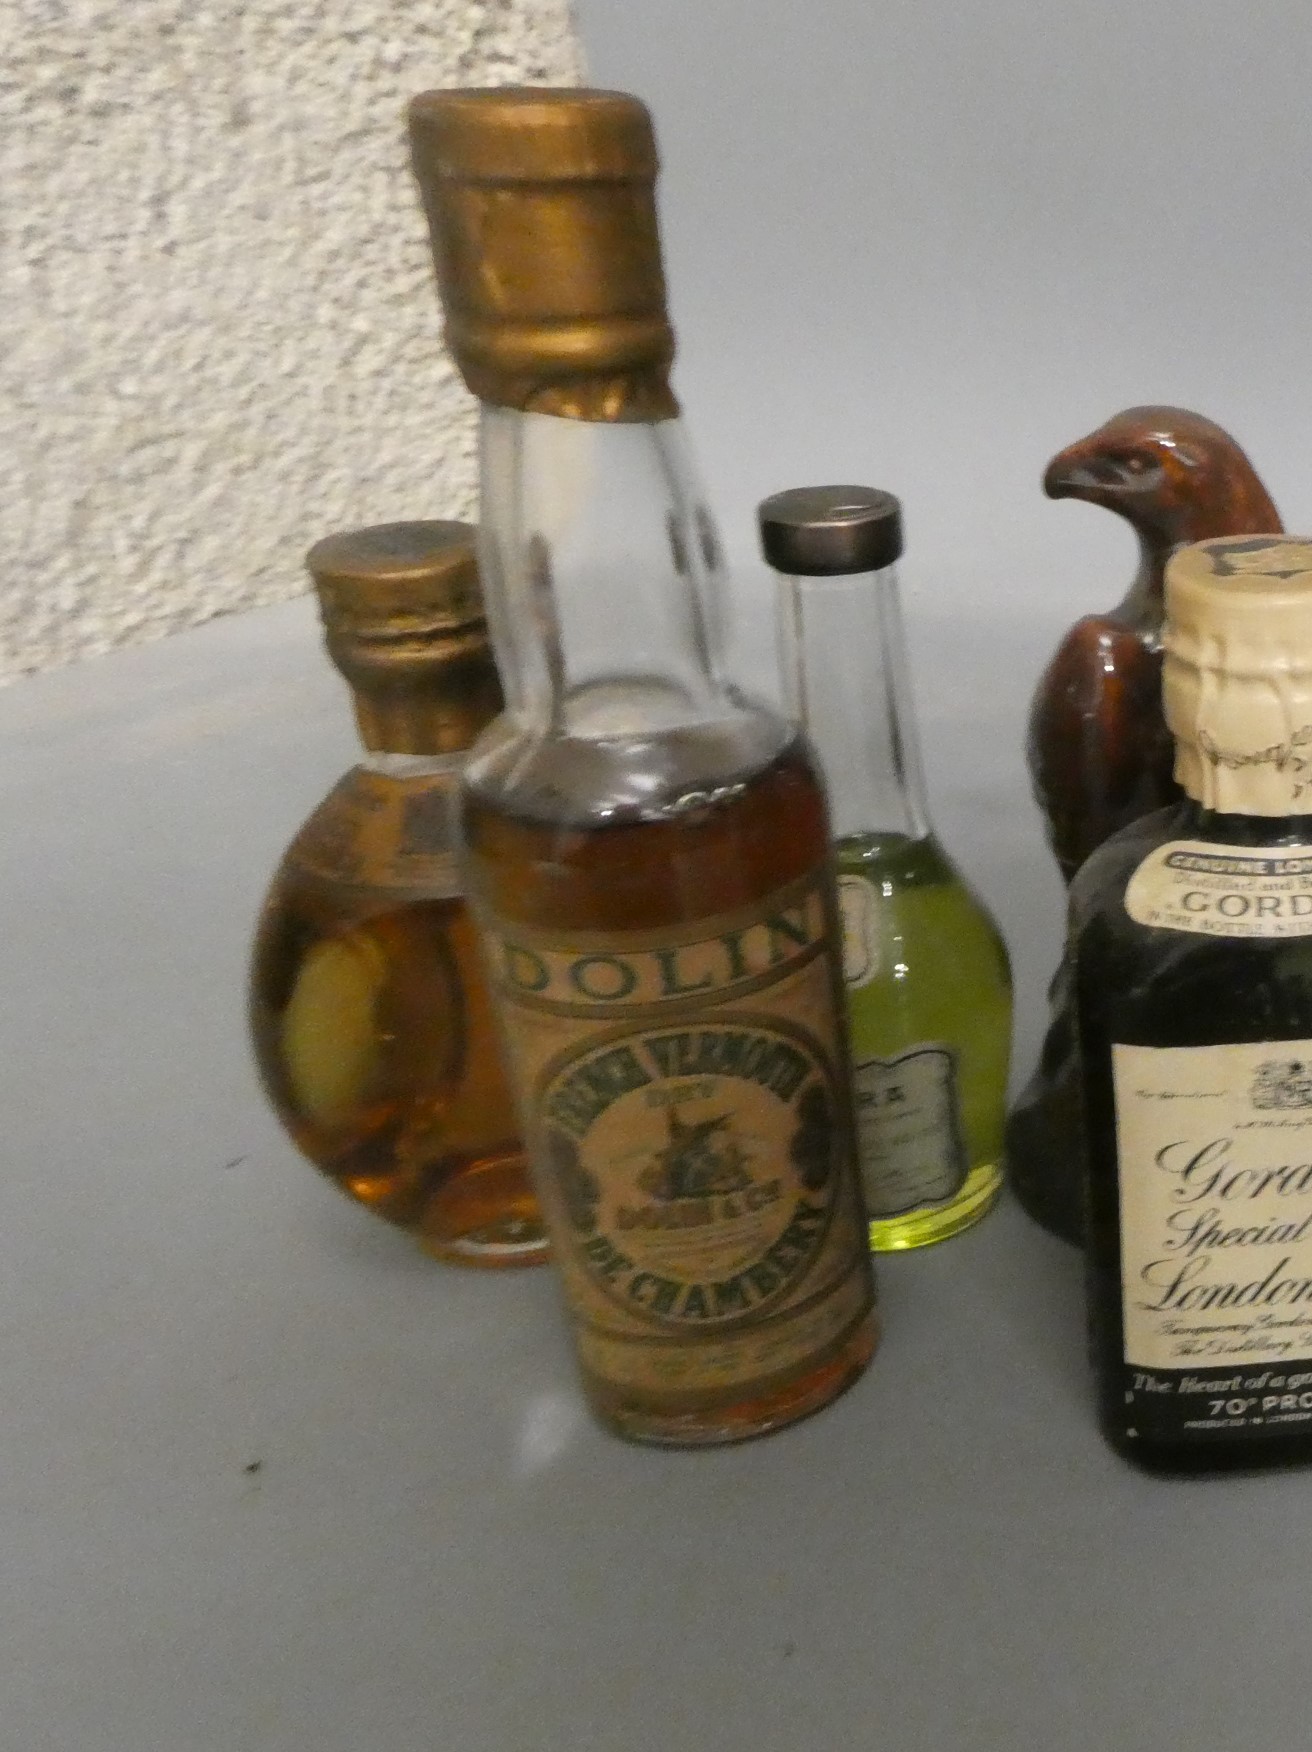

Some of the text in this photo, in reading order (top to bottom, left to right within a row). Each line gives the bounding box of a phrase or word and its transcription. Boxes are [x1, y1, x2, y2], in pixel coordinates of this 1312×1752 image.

[503, 890, 824, 994] DOLIN
[1132, 1371, 1174, 1394] The
[1178, 1373, 1243, 1394] Heart
[1244, 1370, 1273, 1391] of
[1268, 1375, 1286, 1388] a
